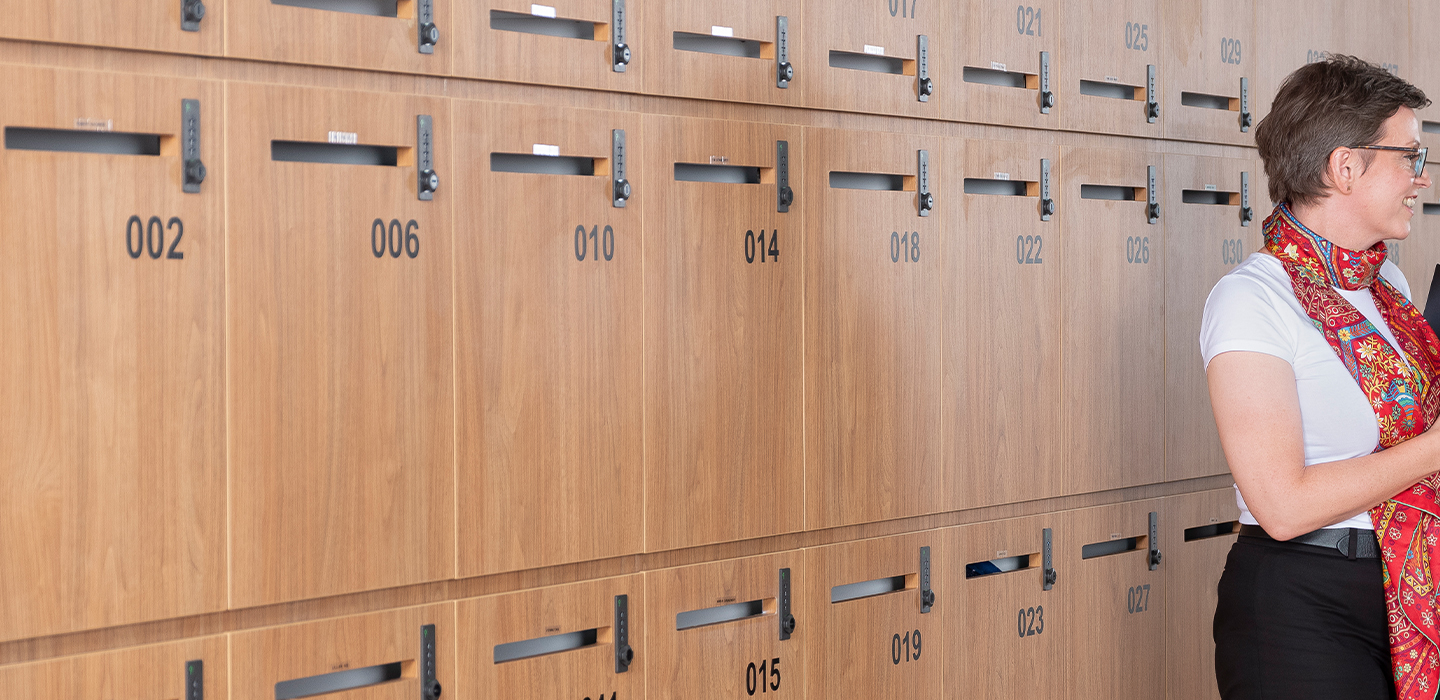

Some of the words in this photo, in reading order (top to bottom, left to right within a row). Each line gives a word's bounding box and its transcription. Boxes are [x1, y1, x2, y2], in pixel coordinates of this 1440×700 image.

[1017, 5, 1042, 37] 021
[1125, 21, 1149, 52] 025
[1220, 37, 1242, 65] 029
[126, 215, 184, 260] 002
[371, 218, 420, 259] 006
[574, 224, 615, 262] 010
[744, 229, 780, 264] 014
[890, 231, 921, 263] 018
[1016, 235, 1043, 265] 022
[1126, 236, 1150, 264] 026
[1222, 239, 1243, 265] 030
[1386, 242, 1400, 266] 38
[1127, 584, 1151, 614] 027
[1017, 605, 1044, 638] 023
[891, 629, 922, 665] 019
[746, 657, 781, 696] 015
